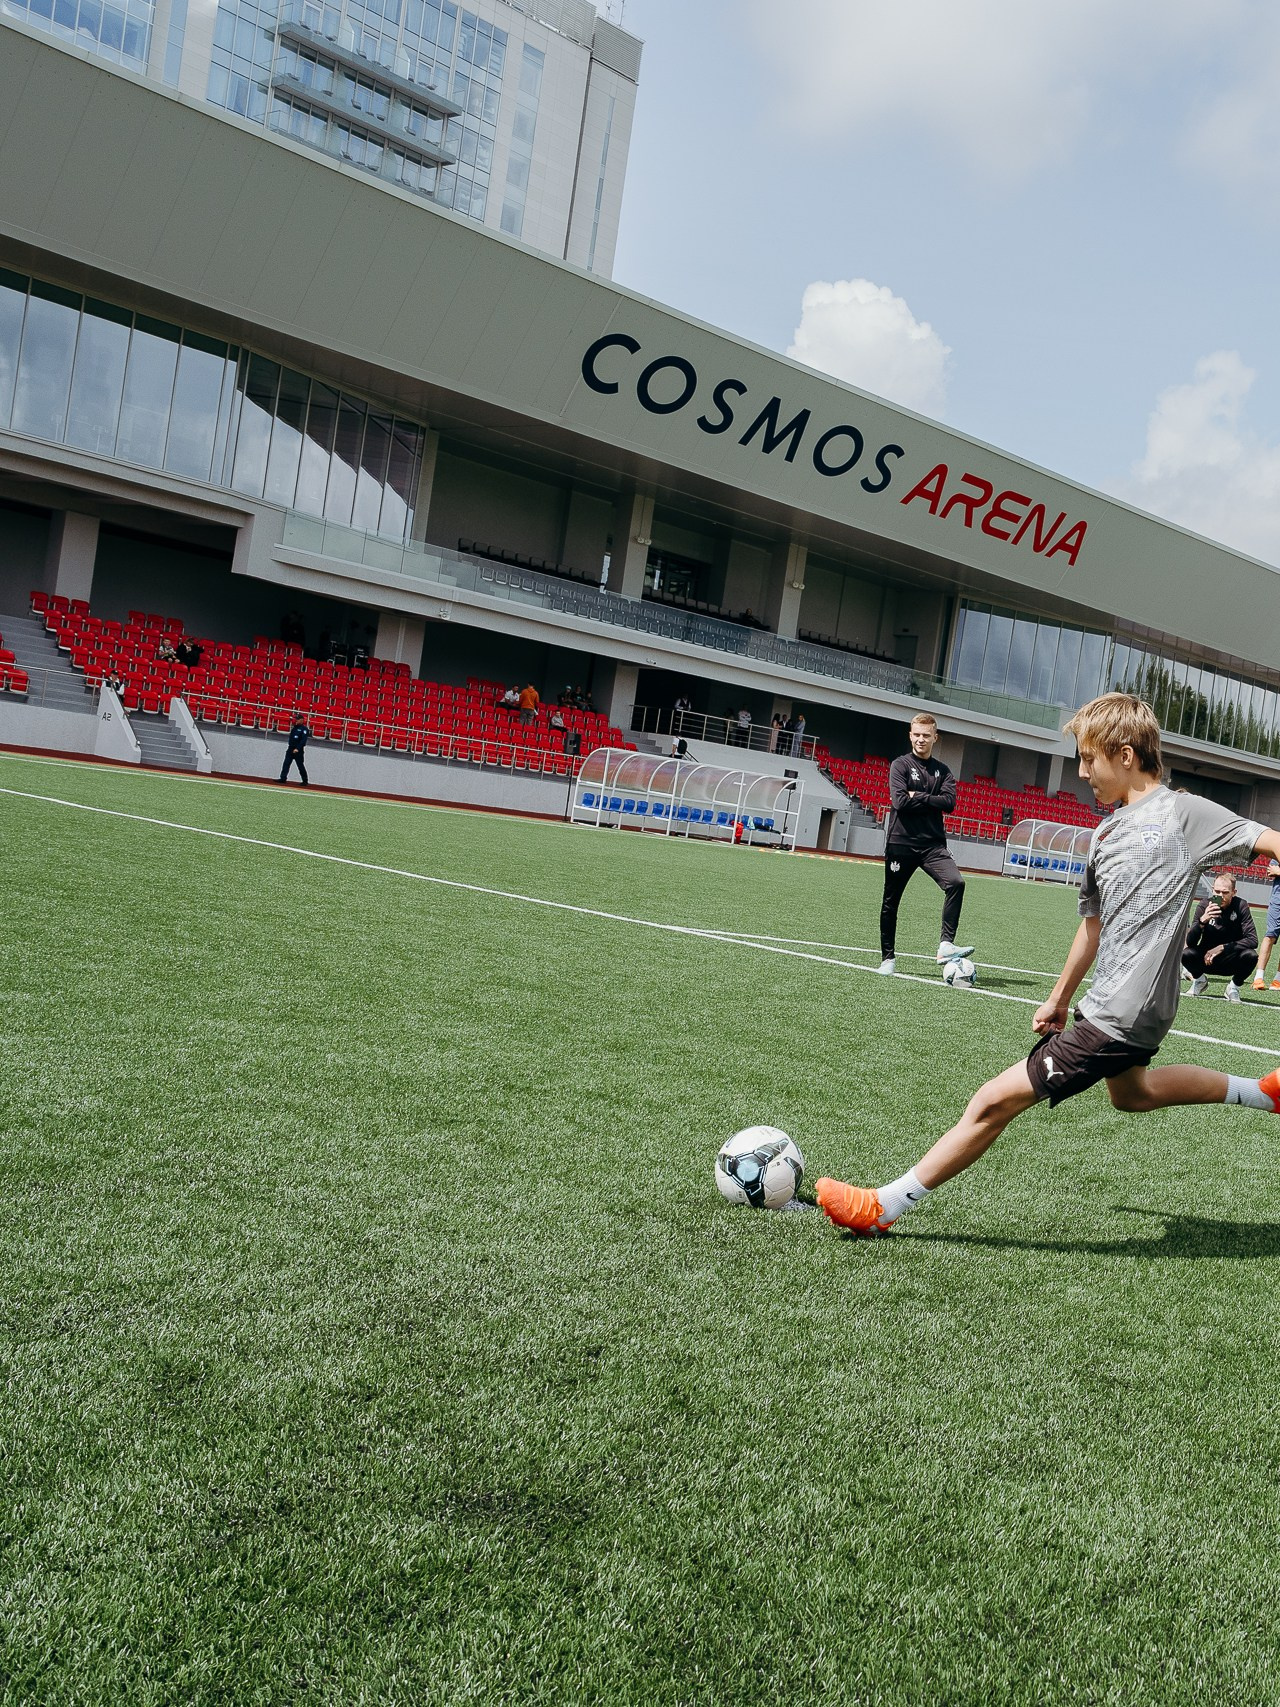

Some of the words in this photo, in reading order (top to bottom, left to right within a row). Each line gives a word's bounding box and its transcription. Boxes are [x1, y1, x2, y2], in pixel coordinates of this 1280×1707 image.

[581, 333, 905, 493] COSMOS
[900, 463, 1088, 567] ARENA
[101, 711, 112, 722] A2
